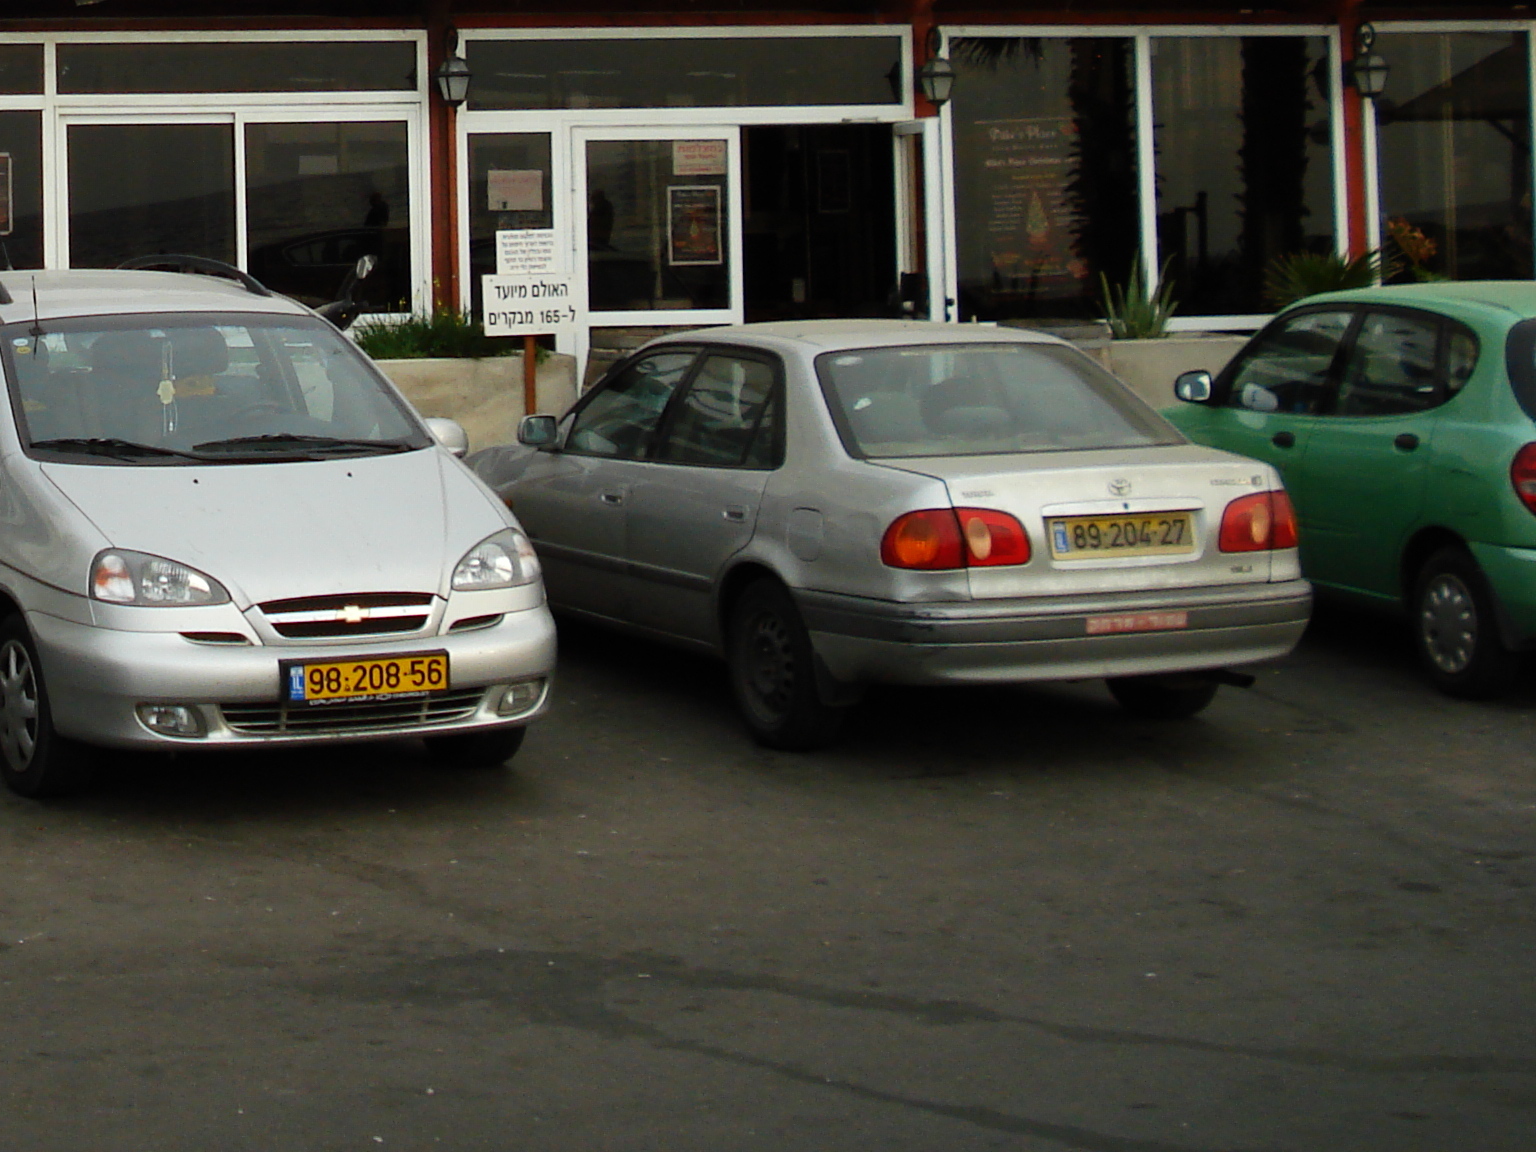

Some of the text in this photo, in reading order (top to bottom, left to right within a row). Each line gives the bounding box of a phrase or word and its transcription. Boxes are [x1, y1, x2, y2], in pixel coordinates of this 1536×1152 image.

[494, 280, 568, 300] האולם מיועד
[489, 311, 534, 328] מבקרים
